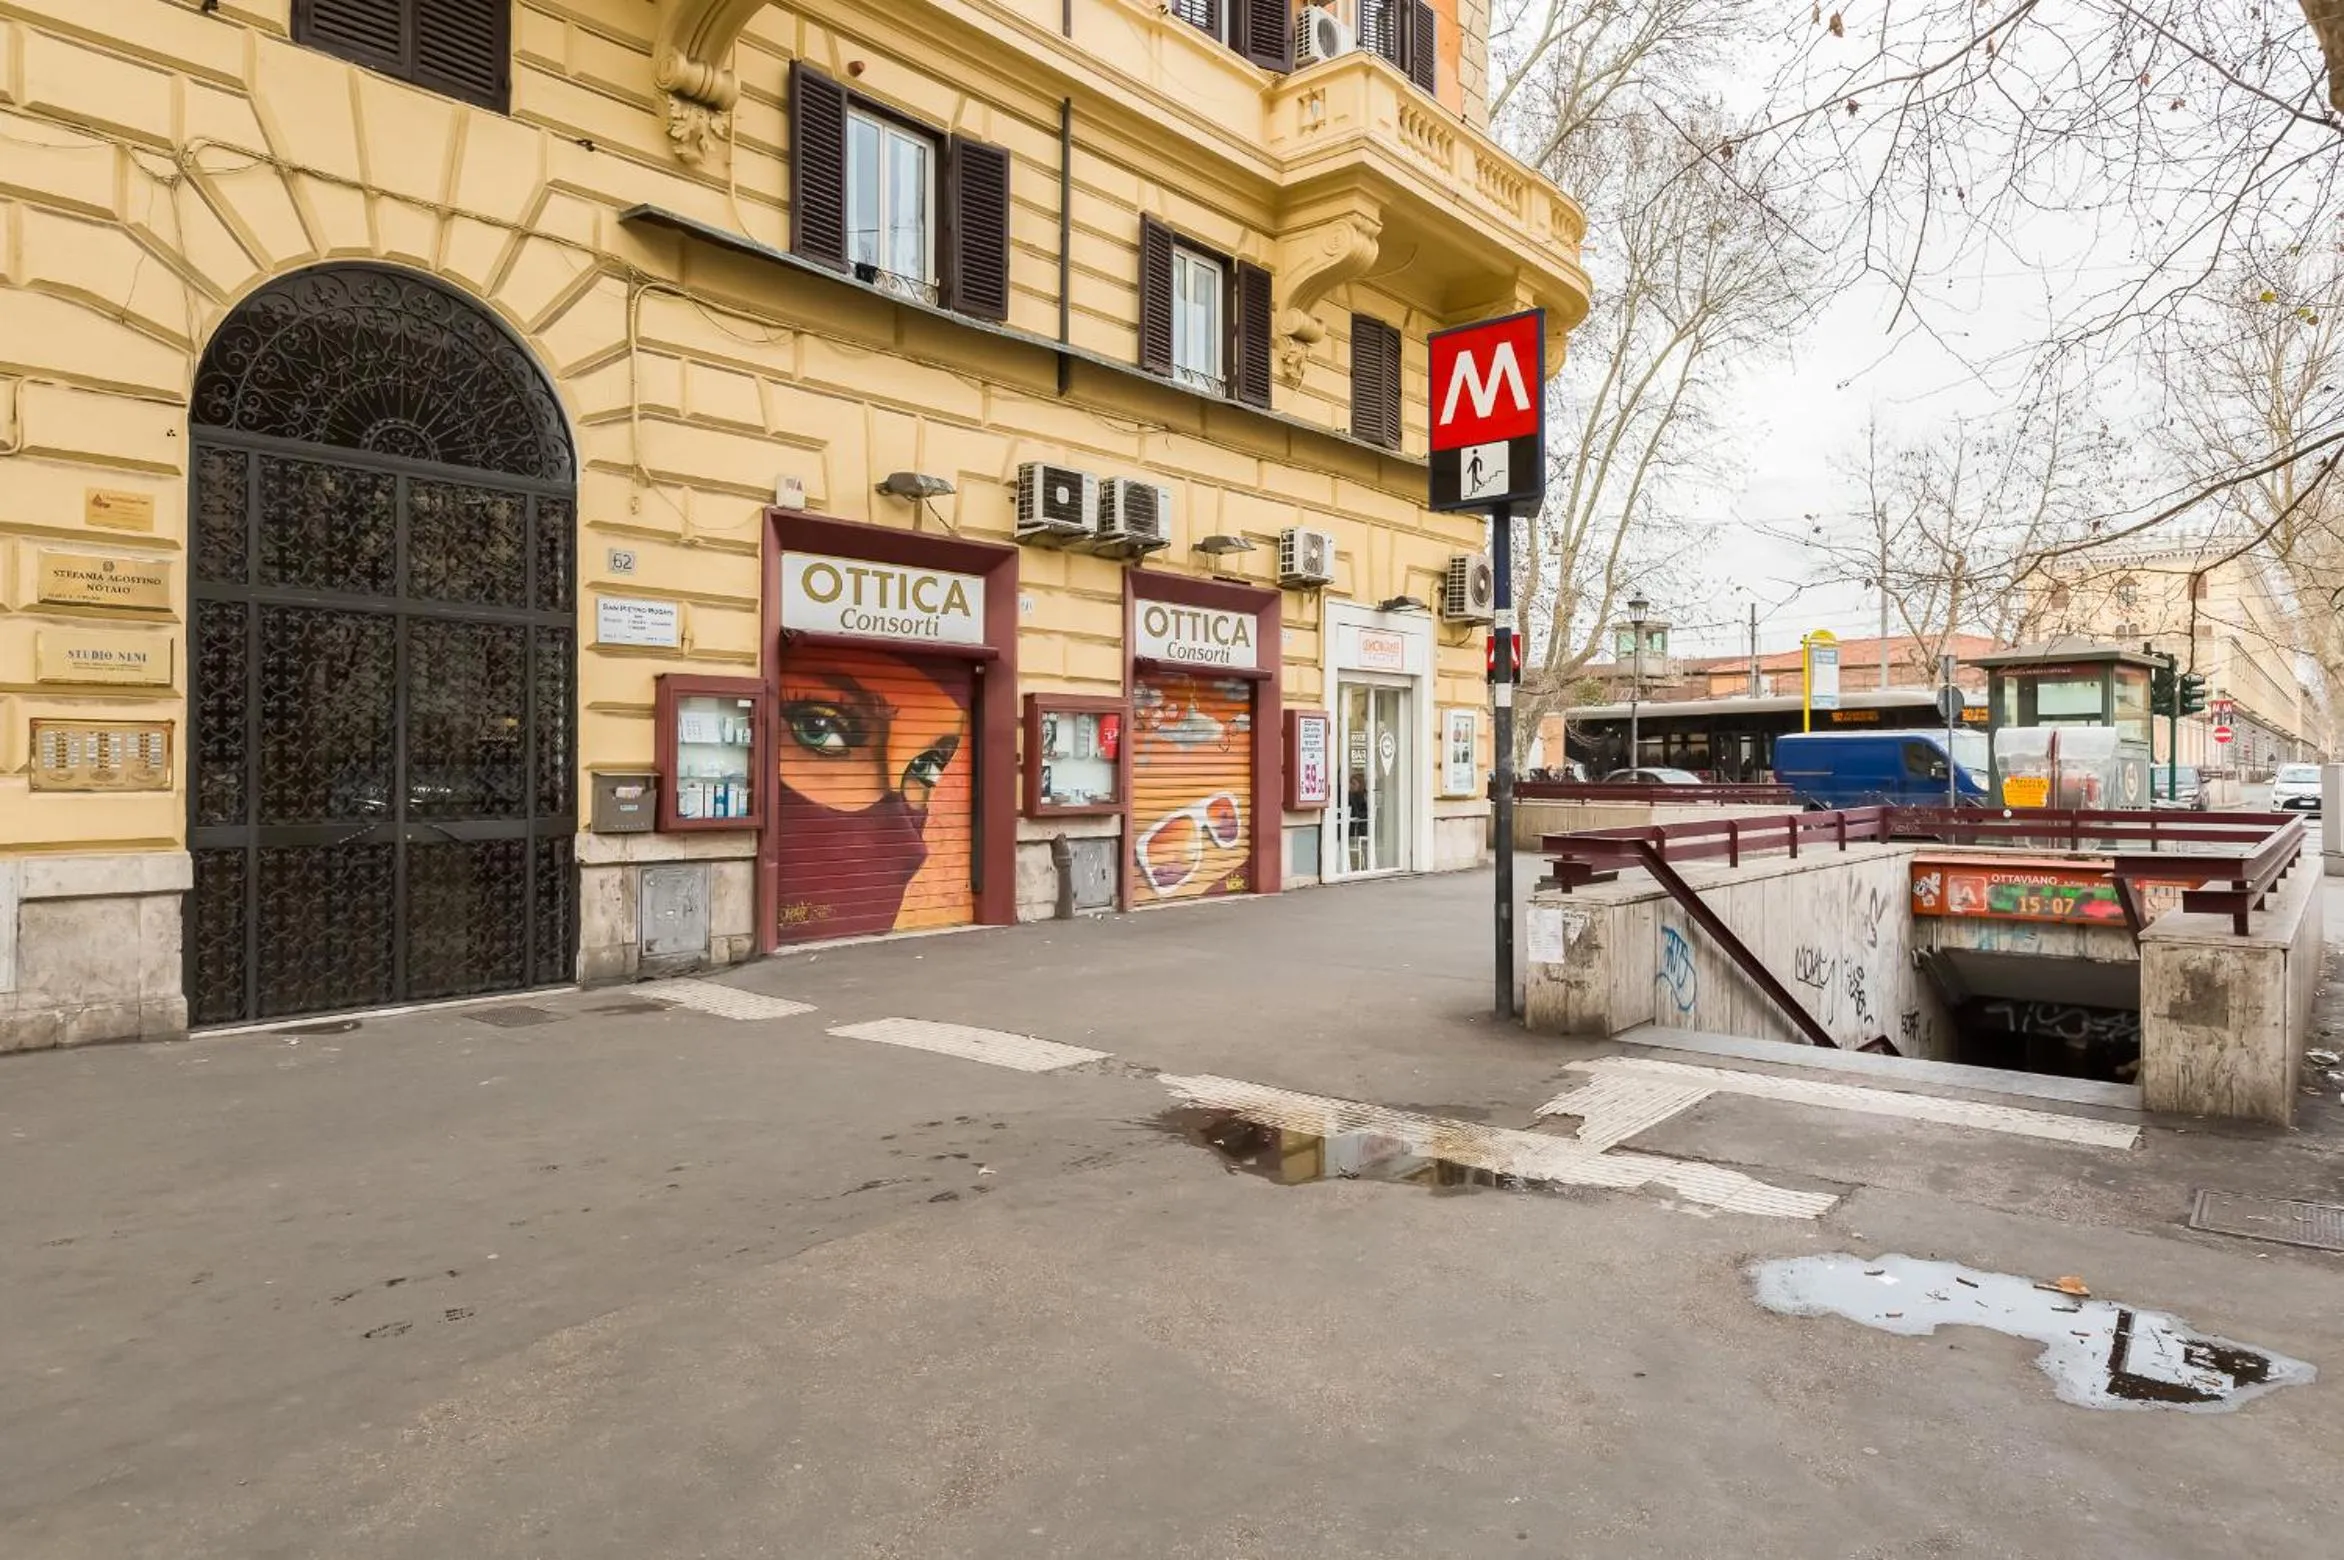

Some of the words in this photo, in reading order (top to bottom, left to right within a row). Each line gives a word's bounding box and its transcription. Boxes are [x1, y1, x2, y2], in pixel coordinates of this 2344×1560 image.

[1440, 342, 1531, 425] M
[613, 553, 632, 570] 62
[53, 569, 104, 582] STEFANIA
[108, 574, 162, 586] AGOSTINO
[86, 584, 131, 595] NOTAIO
[801, 562, 971, 617] OTTICA
[840, 607, 941, 637] Consorti
[1144, 606, 1251, 648] OTTICA
[67, 649, 113, 662] STUDIO
[1166, 641, 1231, 664] Consorti
[1991, 873, 2058, 886] OTTAVIANO
[2018, 895, 2076, 915] 15:07
